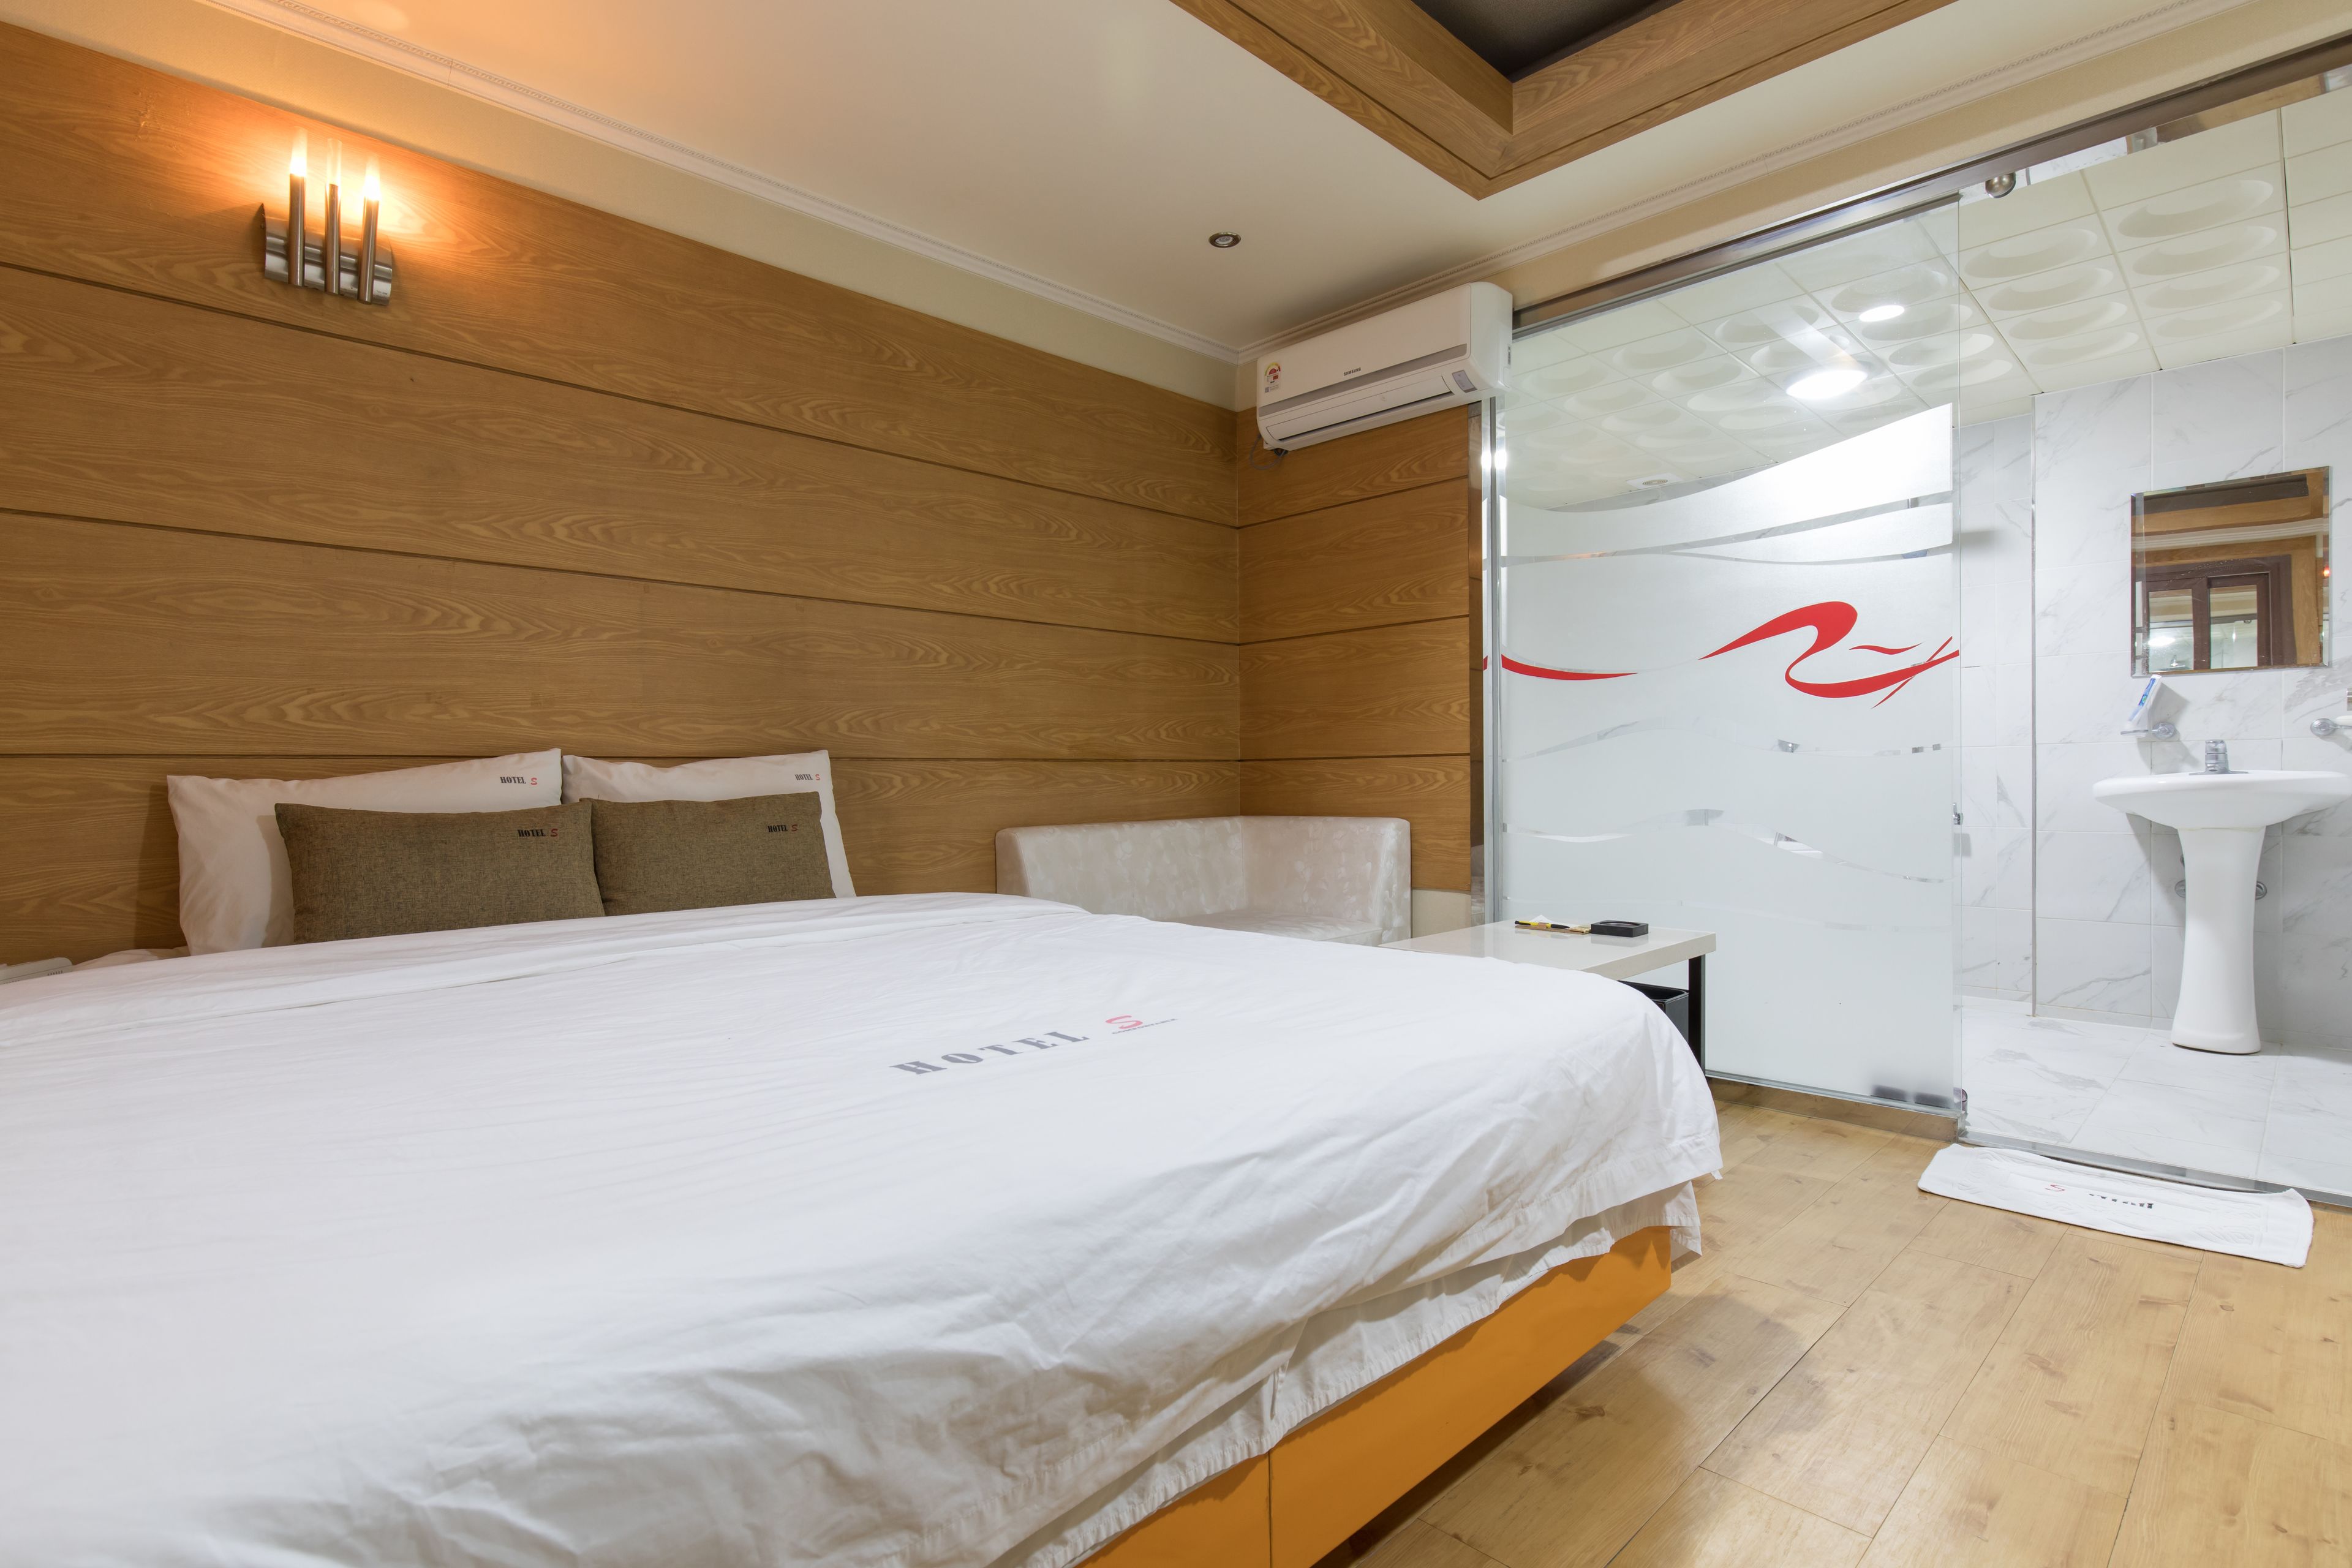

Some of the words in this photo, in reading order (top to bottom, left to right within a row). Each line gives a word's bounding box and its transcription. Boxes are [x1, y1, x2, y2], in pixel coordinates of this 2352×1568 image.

[1343, 367, 1362, 376] SAMSUNG
[518, 829, 546, 837] HOTEL
[550, 828, 559, 837] S
[889, 1031, 1090, 1075] HOTEL
[1105, 1015, 1143, 1030] S
